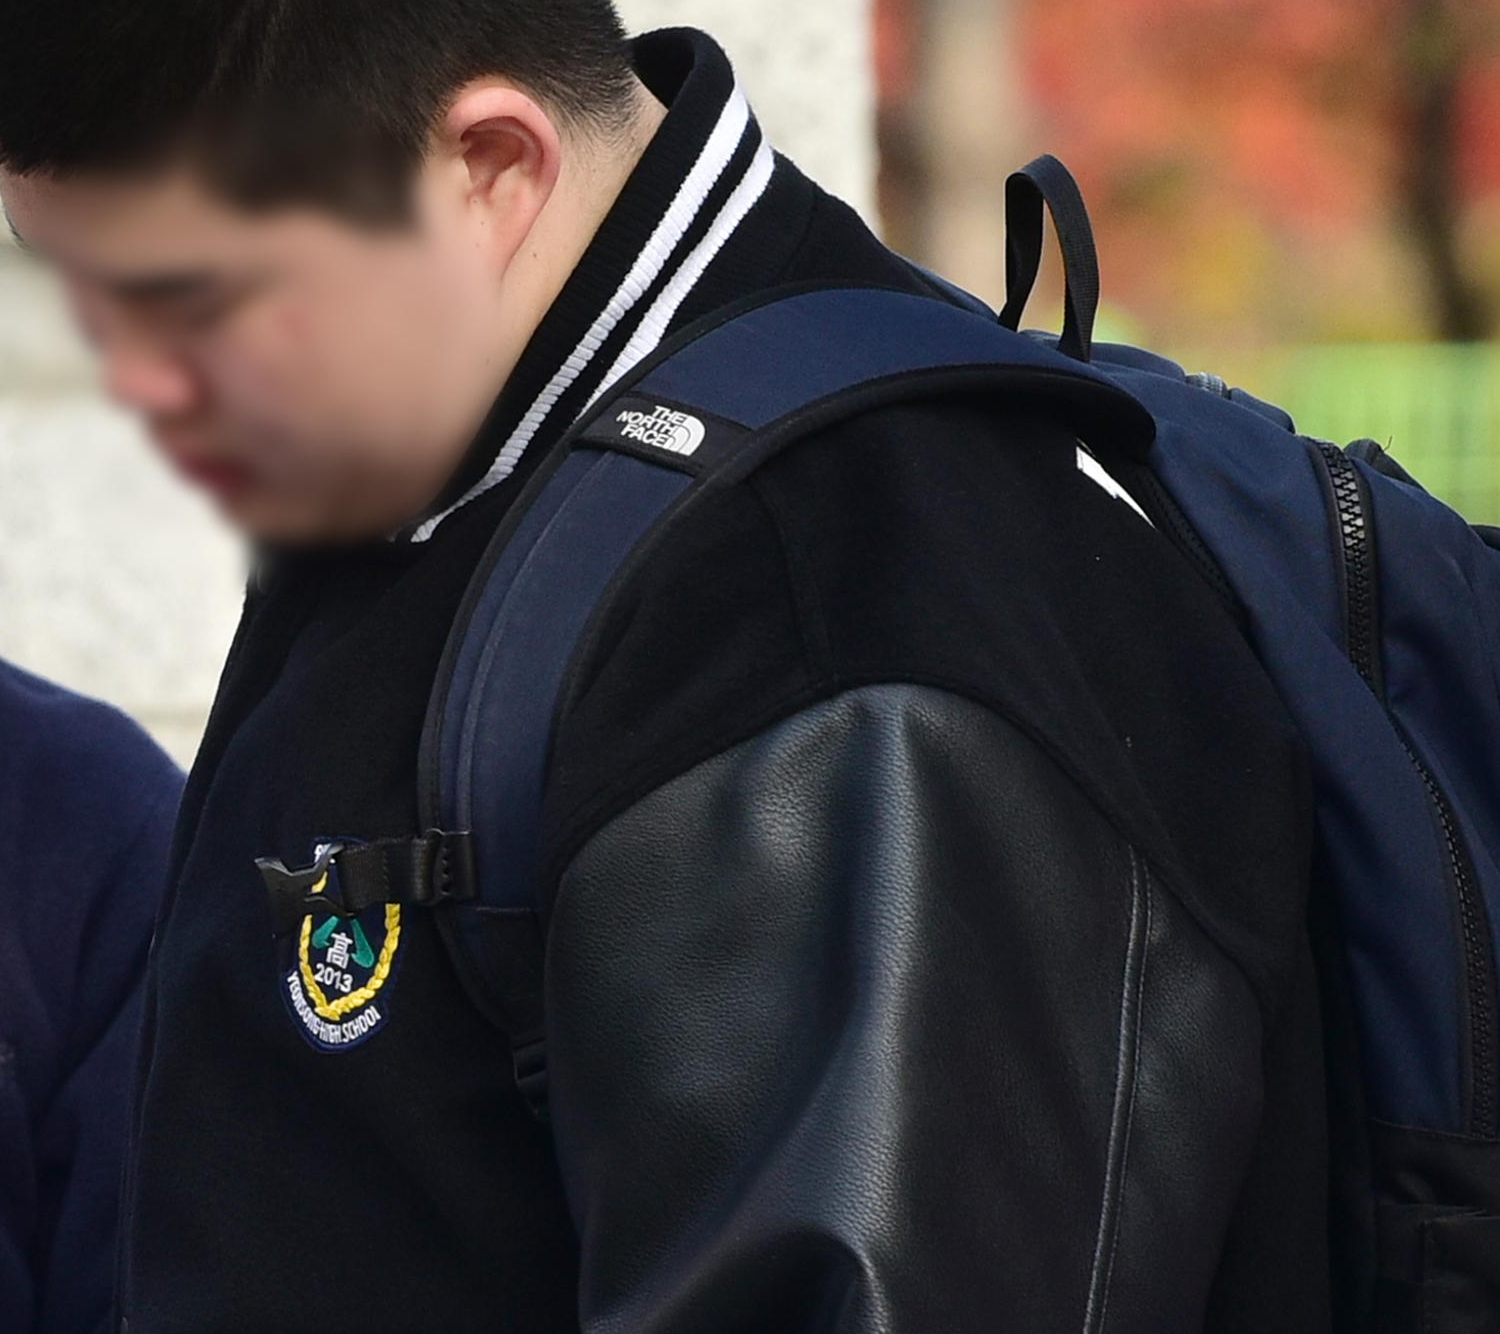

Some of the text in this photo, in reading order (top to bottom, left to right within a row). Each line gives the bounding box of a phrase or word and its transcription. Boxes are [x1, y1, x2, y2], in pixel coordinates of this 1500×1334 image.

[616, 411, 677, 434] NORTH
[652, 405, 688, 424] THE
[621, 424, 671, 447] FACE
[326, 932, 353, 969] 高
[314, 963, 353, 993] 2013
